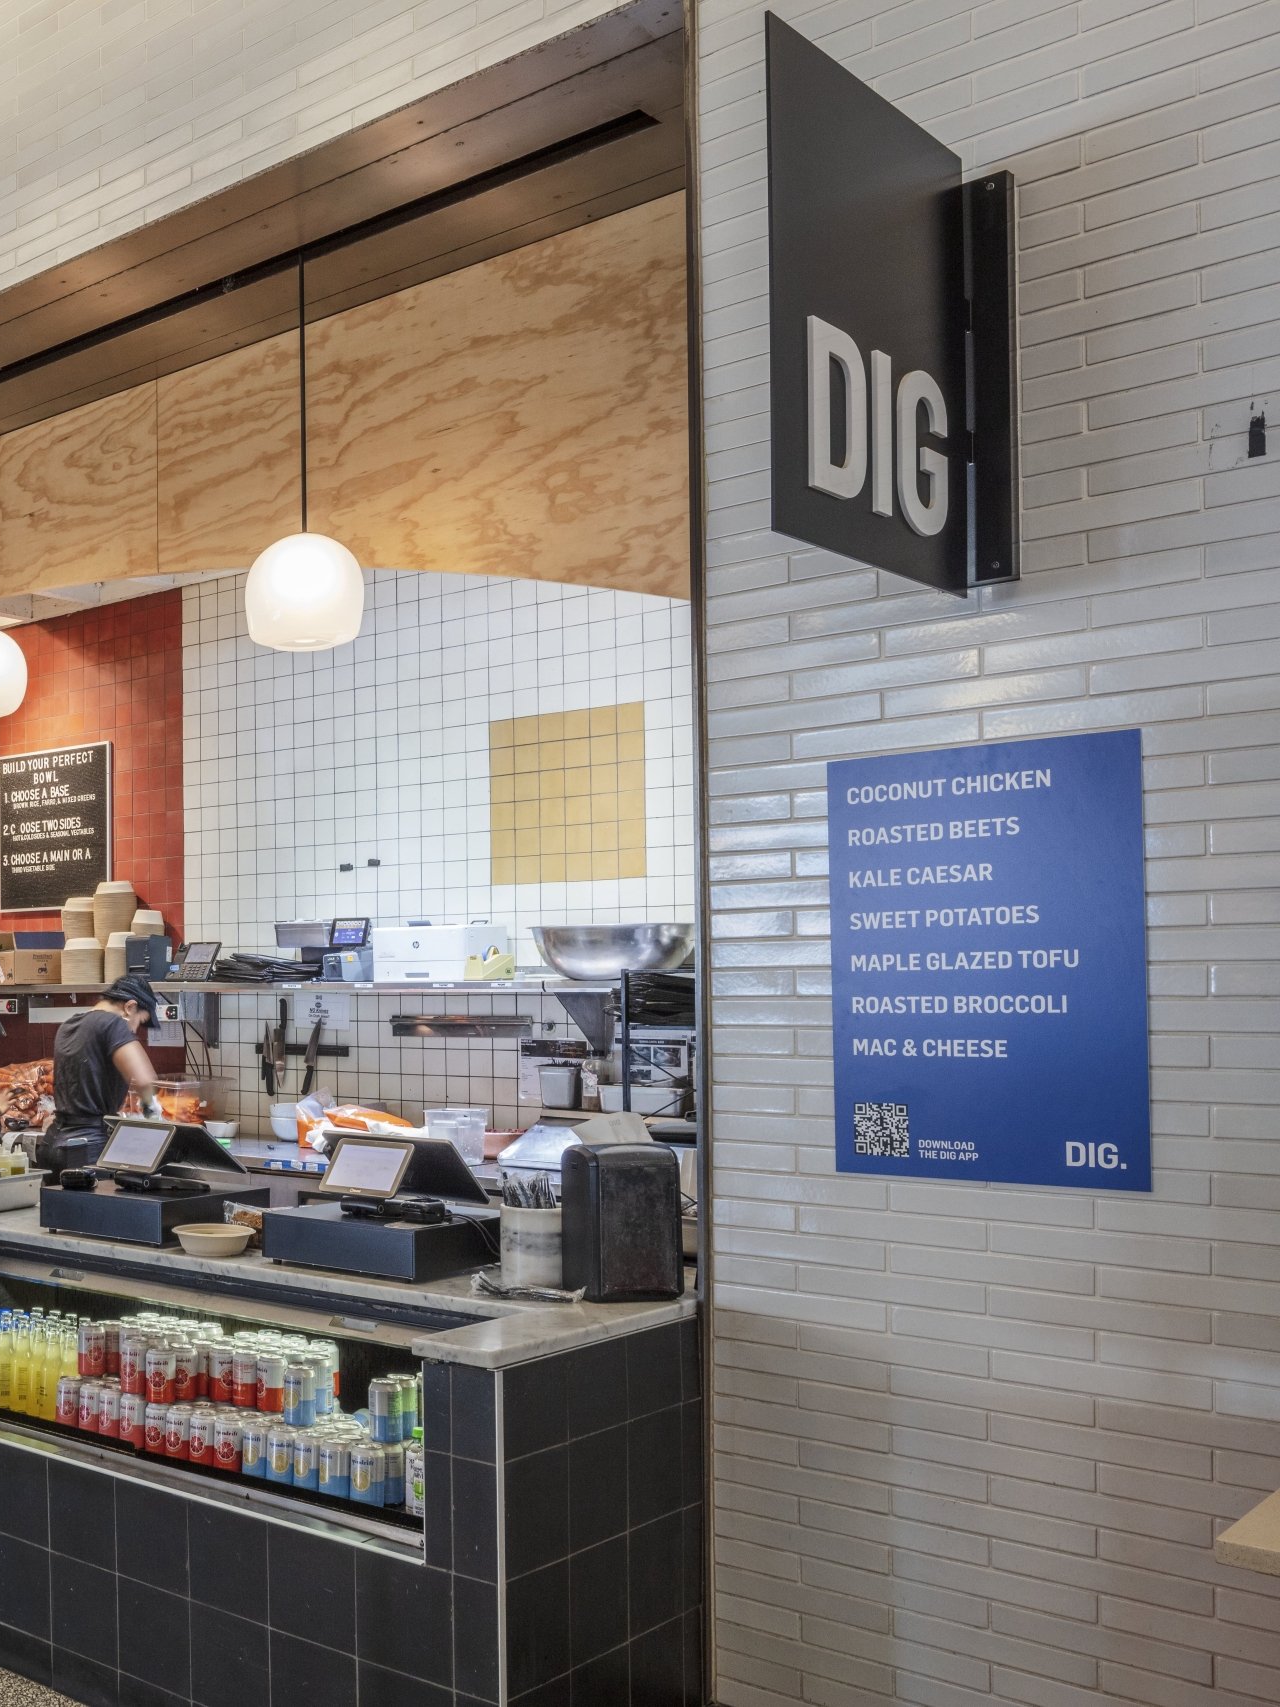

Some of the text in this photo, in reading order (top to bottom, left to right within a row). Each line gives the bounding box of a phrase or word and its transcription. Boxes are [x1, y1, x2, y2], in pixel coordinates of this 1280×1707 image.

[807, 315, 948, 537] DIG
[2, 750, 94, 775] BUILD YOUR PERFECT
[33, 771, 59, 784] BOWL
[847, 768, 1052, 805] COCONUT CHICKEN
[11, 788, 40, 802] CHOOSE
[42, 787, 48, 799] A
[50, 784, 70, 798] BASE
[41, 819, 59, 832] TWO
[59, 816, 81, 830] SIDES
[848, 816, 1020, 847] ROASTED BEETS
[10, 852, 41, 866] CHOOSE
[42, 851, 49, 863] A
[50, 849, 70, 862] MAIN
[72, 848, 83, 861] OR
[85, 847, 91, 860] A
[849, 863, 993, 889] KALE CAESAR
[850, 905, 1039, 931] SWEET POTATOES
[851, 949, 1079, 972] MAPLE GLAZED TOFU
[852, 994, 1068, 1015] ROASTED BROCCOLI
[853, 1038, 1008, 1058] MAC & CHEESE
[918, 1139, 975, 1151] DOWNLOAD
[919, 1149, 979, 1162] THE DIG APP
[1065, 1141, 1127, 1170] DIG.
